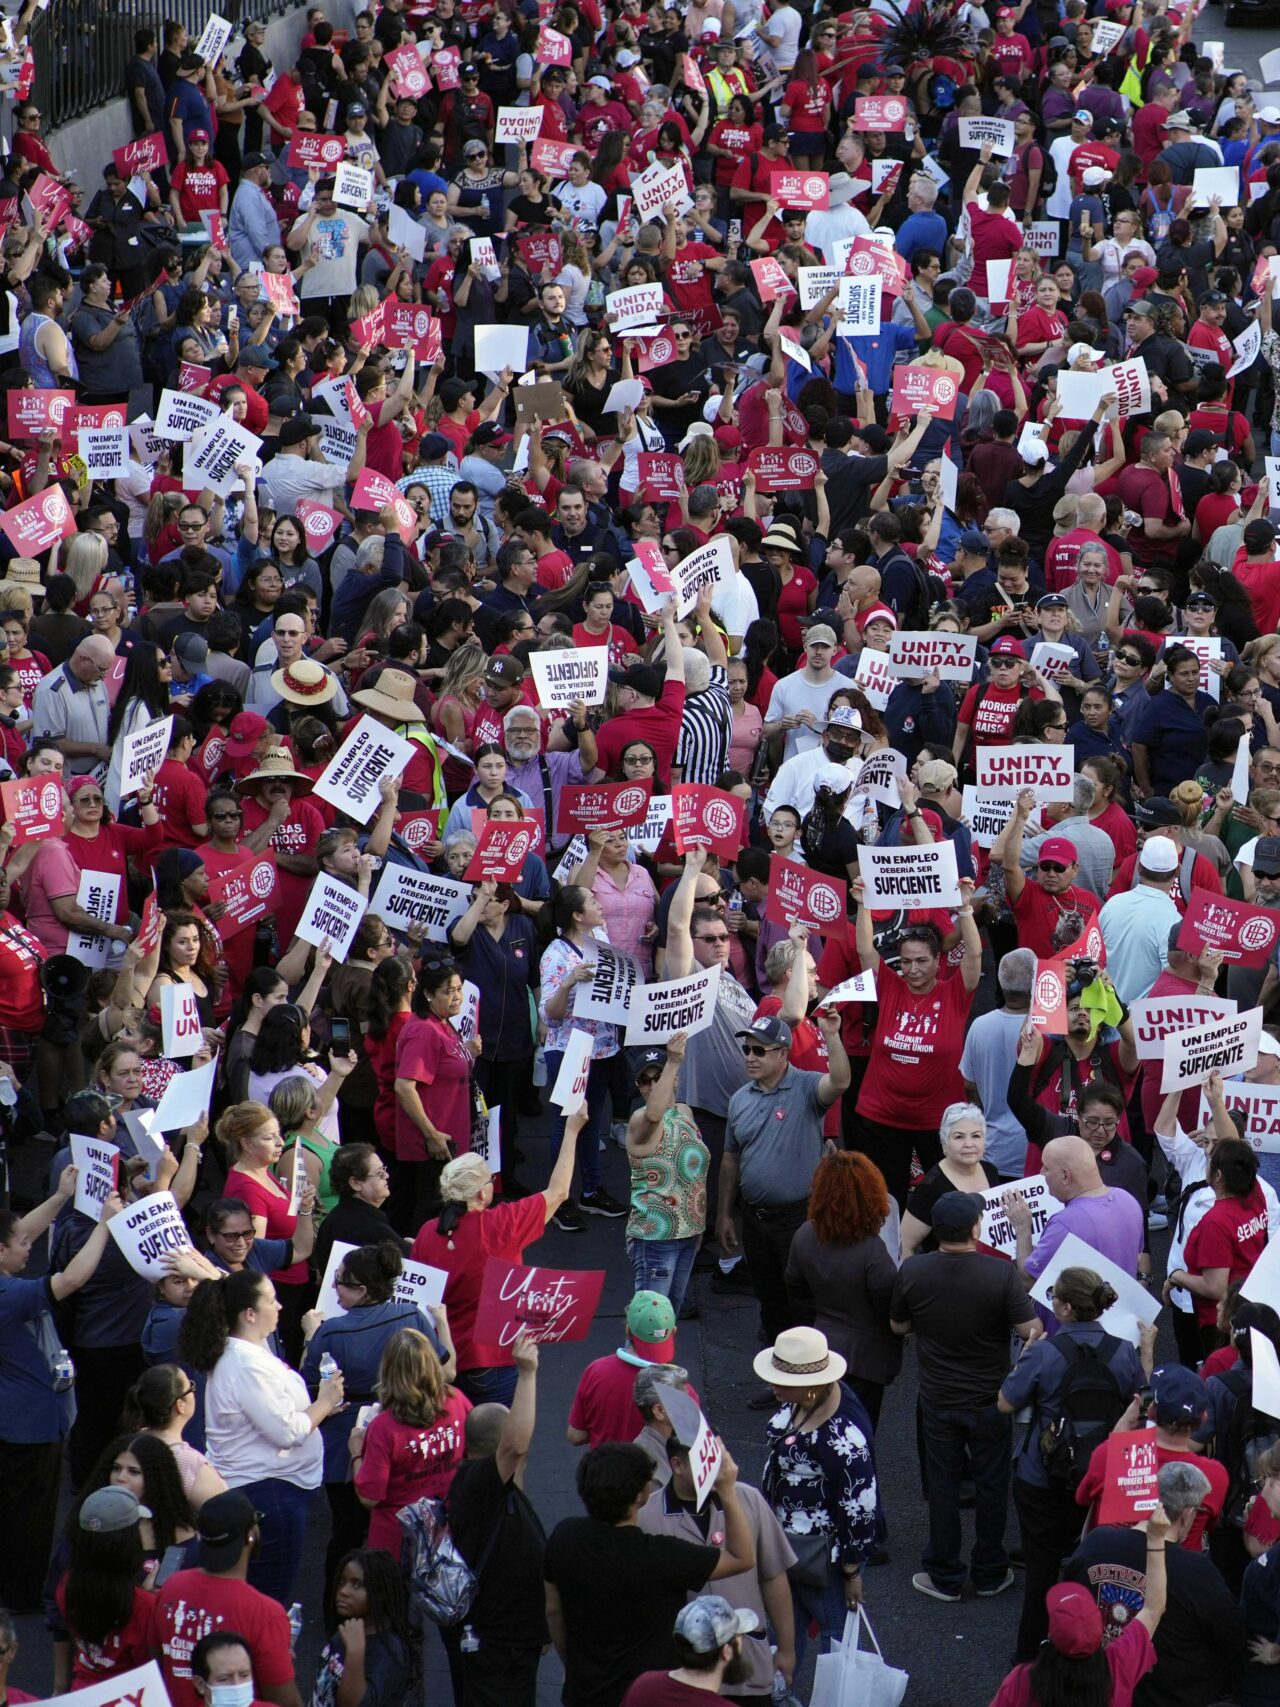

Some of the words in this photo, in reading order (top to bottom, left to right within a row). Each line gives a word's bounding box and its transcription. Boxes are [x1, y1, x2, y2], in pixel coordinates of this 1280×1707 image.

[499, 116, 540, 126] UNIDAD
[503, 127, 536, 135] UNITY
[641, 180, 684, 211] UNIDAD
[642, 173, 678, 200] UNITY
[613, 291, 656, 308] UNITY
[848, 285, 861, 324] SUFICIENTE
[1112, 366, 1128, 415] UNIDAD
[1126, 369, 1141, 408] UNITY
[188, 402, 212, 416] EMPLEO
[194, 457, 205, 467] UN
[203, 429, 225, 458] EMPLEO
[649, 436, 663, 447] NIKE
[88, 451, 121, 467] SUFICIENTE
[209, 439, 245, 482] SUFICIENTE
[679, 567, 689, 578] UN
[689, 549, 717, 572] EMPLEO
[683, 566, 721, 603] SUFICIENTE
[902, 641, 965, 654] UNITY
[892, 654, 971, 667] UNIDAD
[546, 661, 598, 681] SUFICIENTE
[481, 719, 500, 737] VEGAS
[1003, 715, 1009, 723] A
[132, 737, 142, 749] UN
[143, 728, 165, 745] EMPLEO
[329, 770, 341, 786] UN
[336, 732, 370, 771] EMPLEO
[362, 743, 374, 760] SER
[130, 748, 162, 778] SUFICIENTE
[990, 756, 1061, 771] UNITY
[347, 745, 395, 803] SUFICIENTE
[981, 771, 1070, 786] UNIDAD
[872, 855, 891, 864] UN
[893, 853, 939, 864] EMPLEO
[398, 875, 417, 887] UN
[417, 881, 458, 898] EMPLEO
[875, 875, 941, 895] SUFICIENTE
[325, 886, 337, 898] UN
[336, 894, 358, 912] EMPLEO
[434, 897, 448, 906] SER
[386, 894, 450, 927] SUFICIENTE
[311, 907, 350, 943] SUFICIENTE
[1194, 921, 1215, 936] WORKERS
[1216, 931, 1232, 940] UNION
[1203, 919, 1227, 932] CULINARY
[648, 991, 668, 1002] UN
[671, 979, 708, 998] EMPLEO
[690, 993, 701, 1003] SER
[644, 1001, 705, 1032] SUFICIENTE
[894, 1032, 923, 1044] CULINARY
[1182, 1036, 1201, 1047] UN
[1204, 1022, 1247, 1041] EMPLEO
[1226, 1036, 1240, 1044] SER
[884, 1036, 910, 1050] WORKERS
[912, 1044, 934, 1052] UNION
[1179, 1044, 1244, 1077] SUFICIENTE
[87, 1147, 100, 1159] UN
[126, 1211, 148, 1229] UN
[1118, 1476, 1142, 1486] WORKERS
[1128, 1468, 1152, 1477] CULINARY
